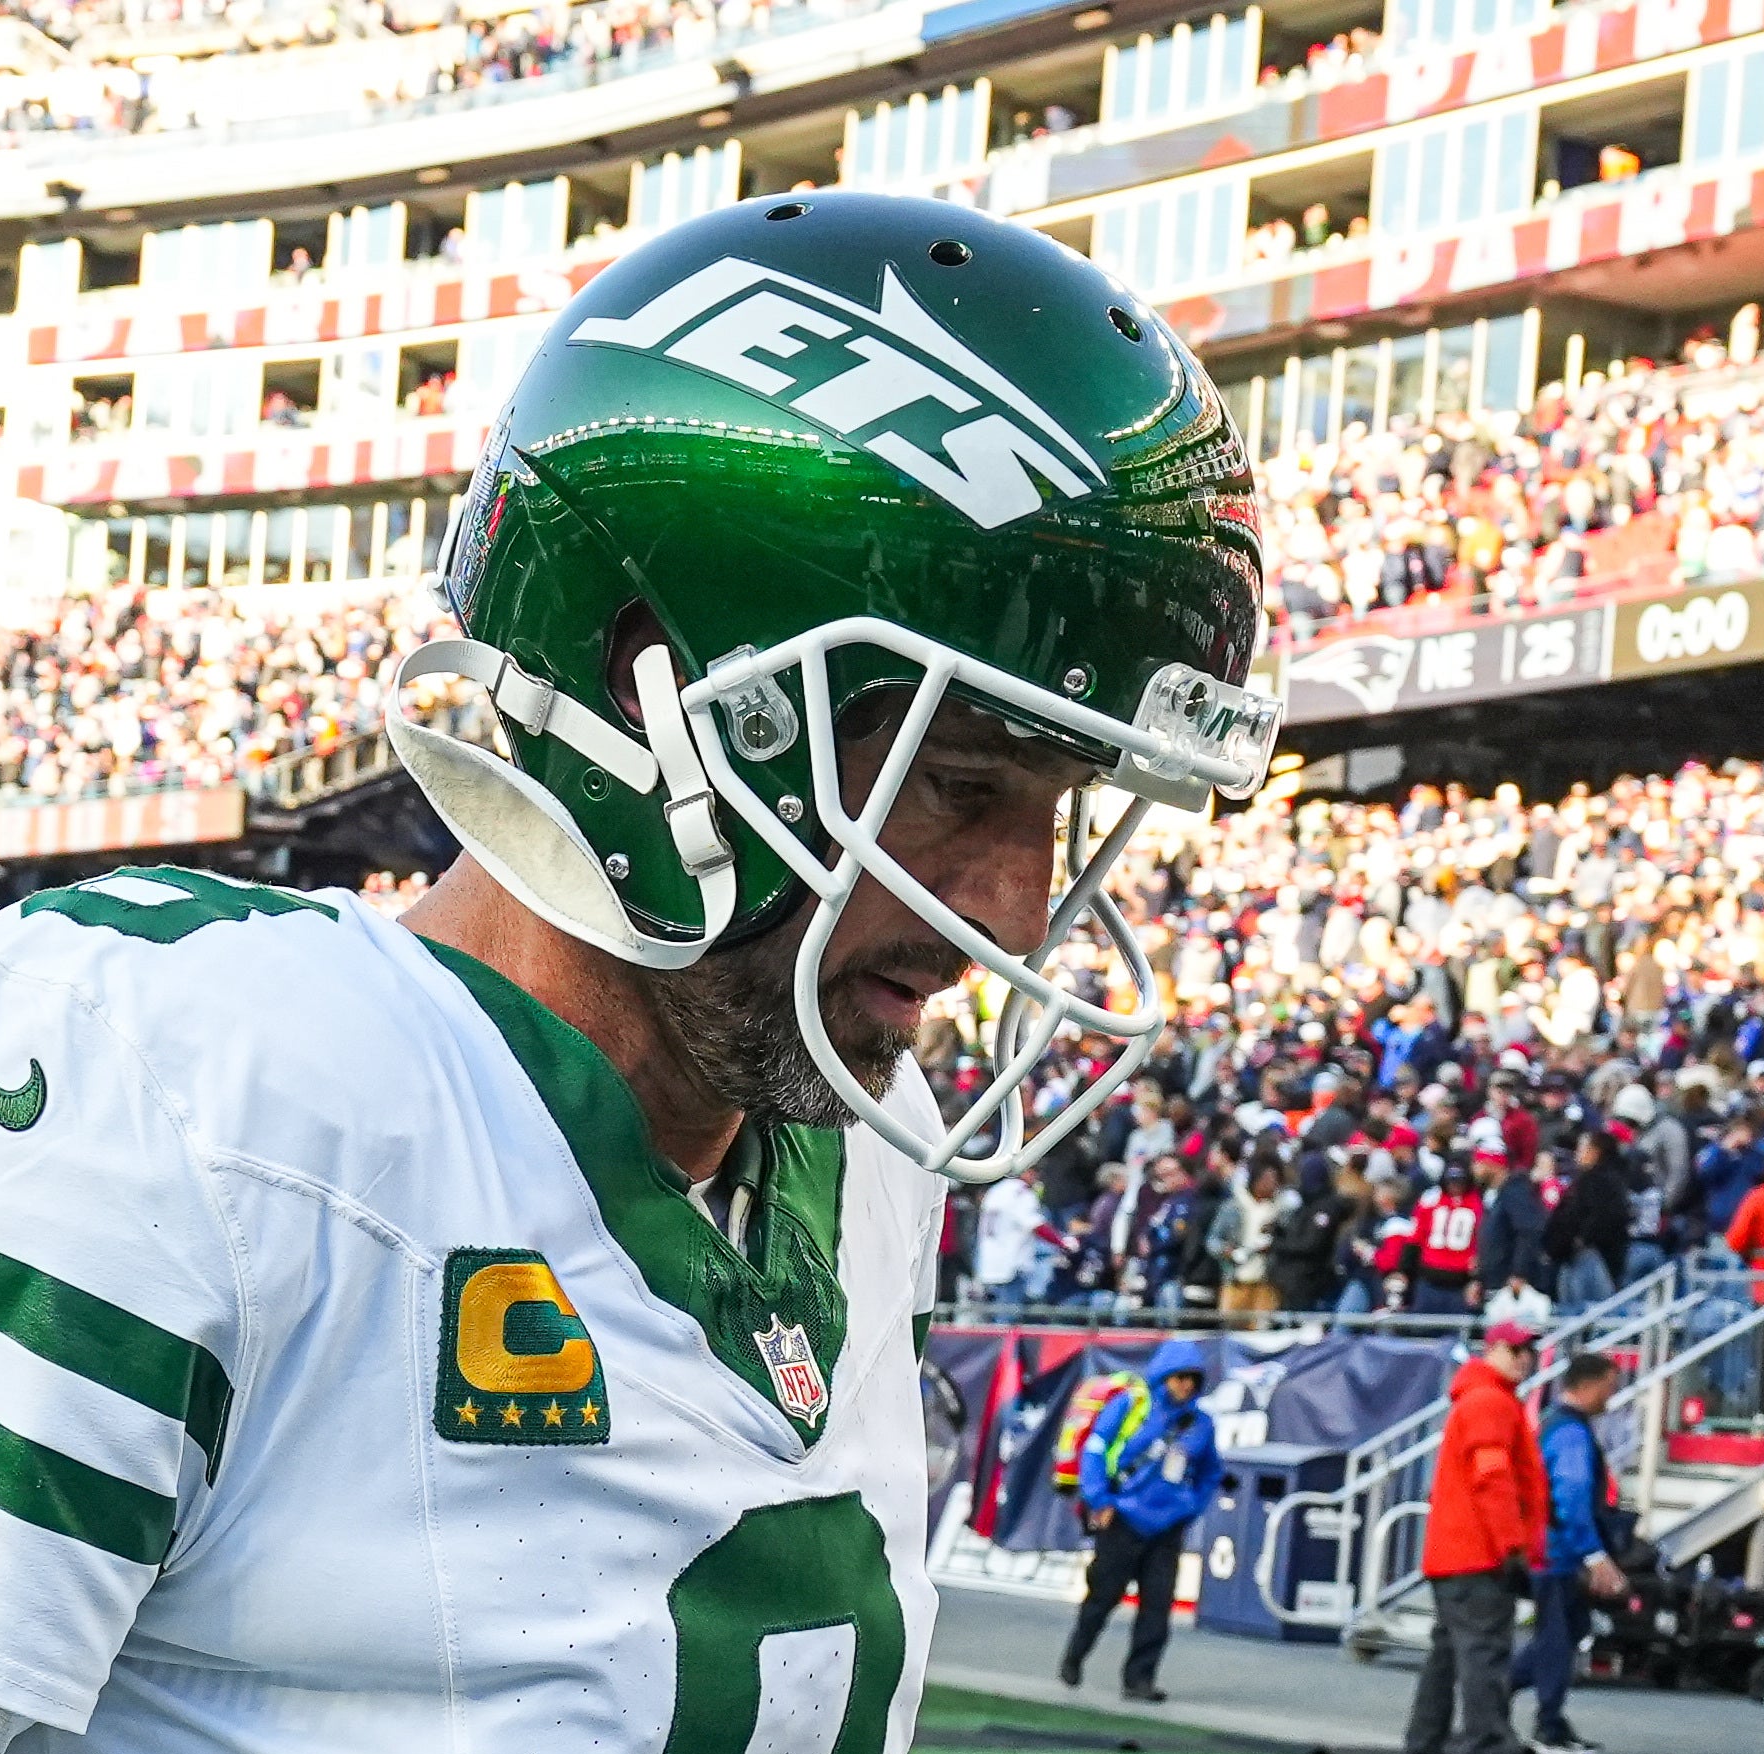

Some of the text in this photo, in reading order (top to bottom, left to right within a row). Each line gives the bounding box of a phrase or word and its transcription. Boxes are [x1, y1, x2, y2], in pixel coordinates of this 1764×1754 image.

[568, 255, 1108, 530] JETS
[1419, 624, 1575, 693] NE 25
[1637, 592, 1749, 663] 0:00
[1428, 1205, 1477, 1250] 10
[457, 1262, 593, 1393] C
[779, 1364, 821, 1407] NFL
